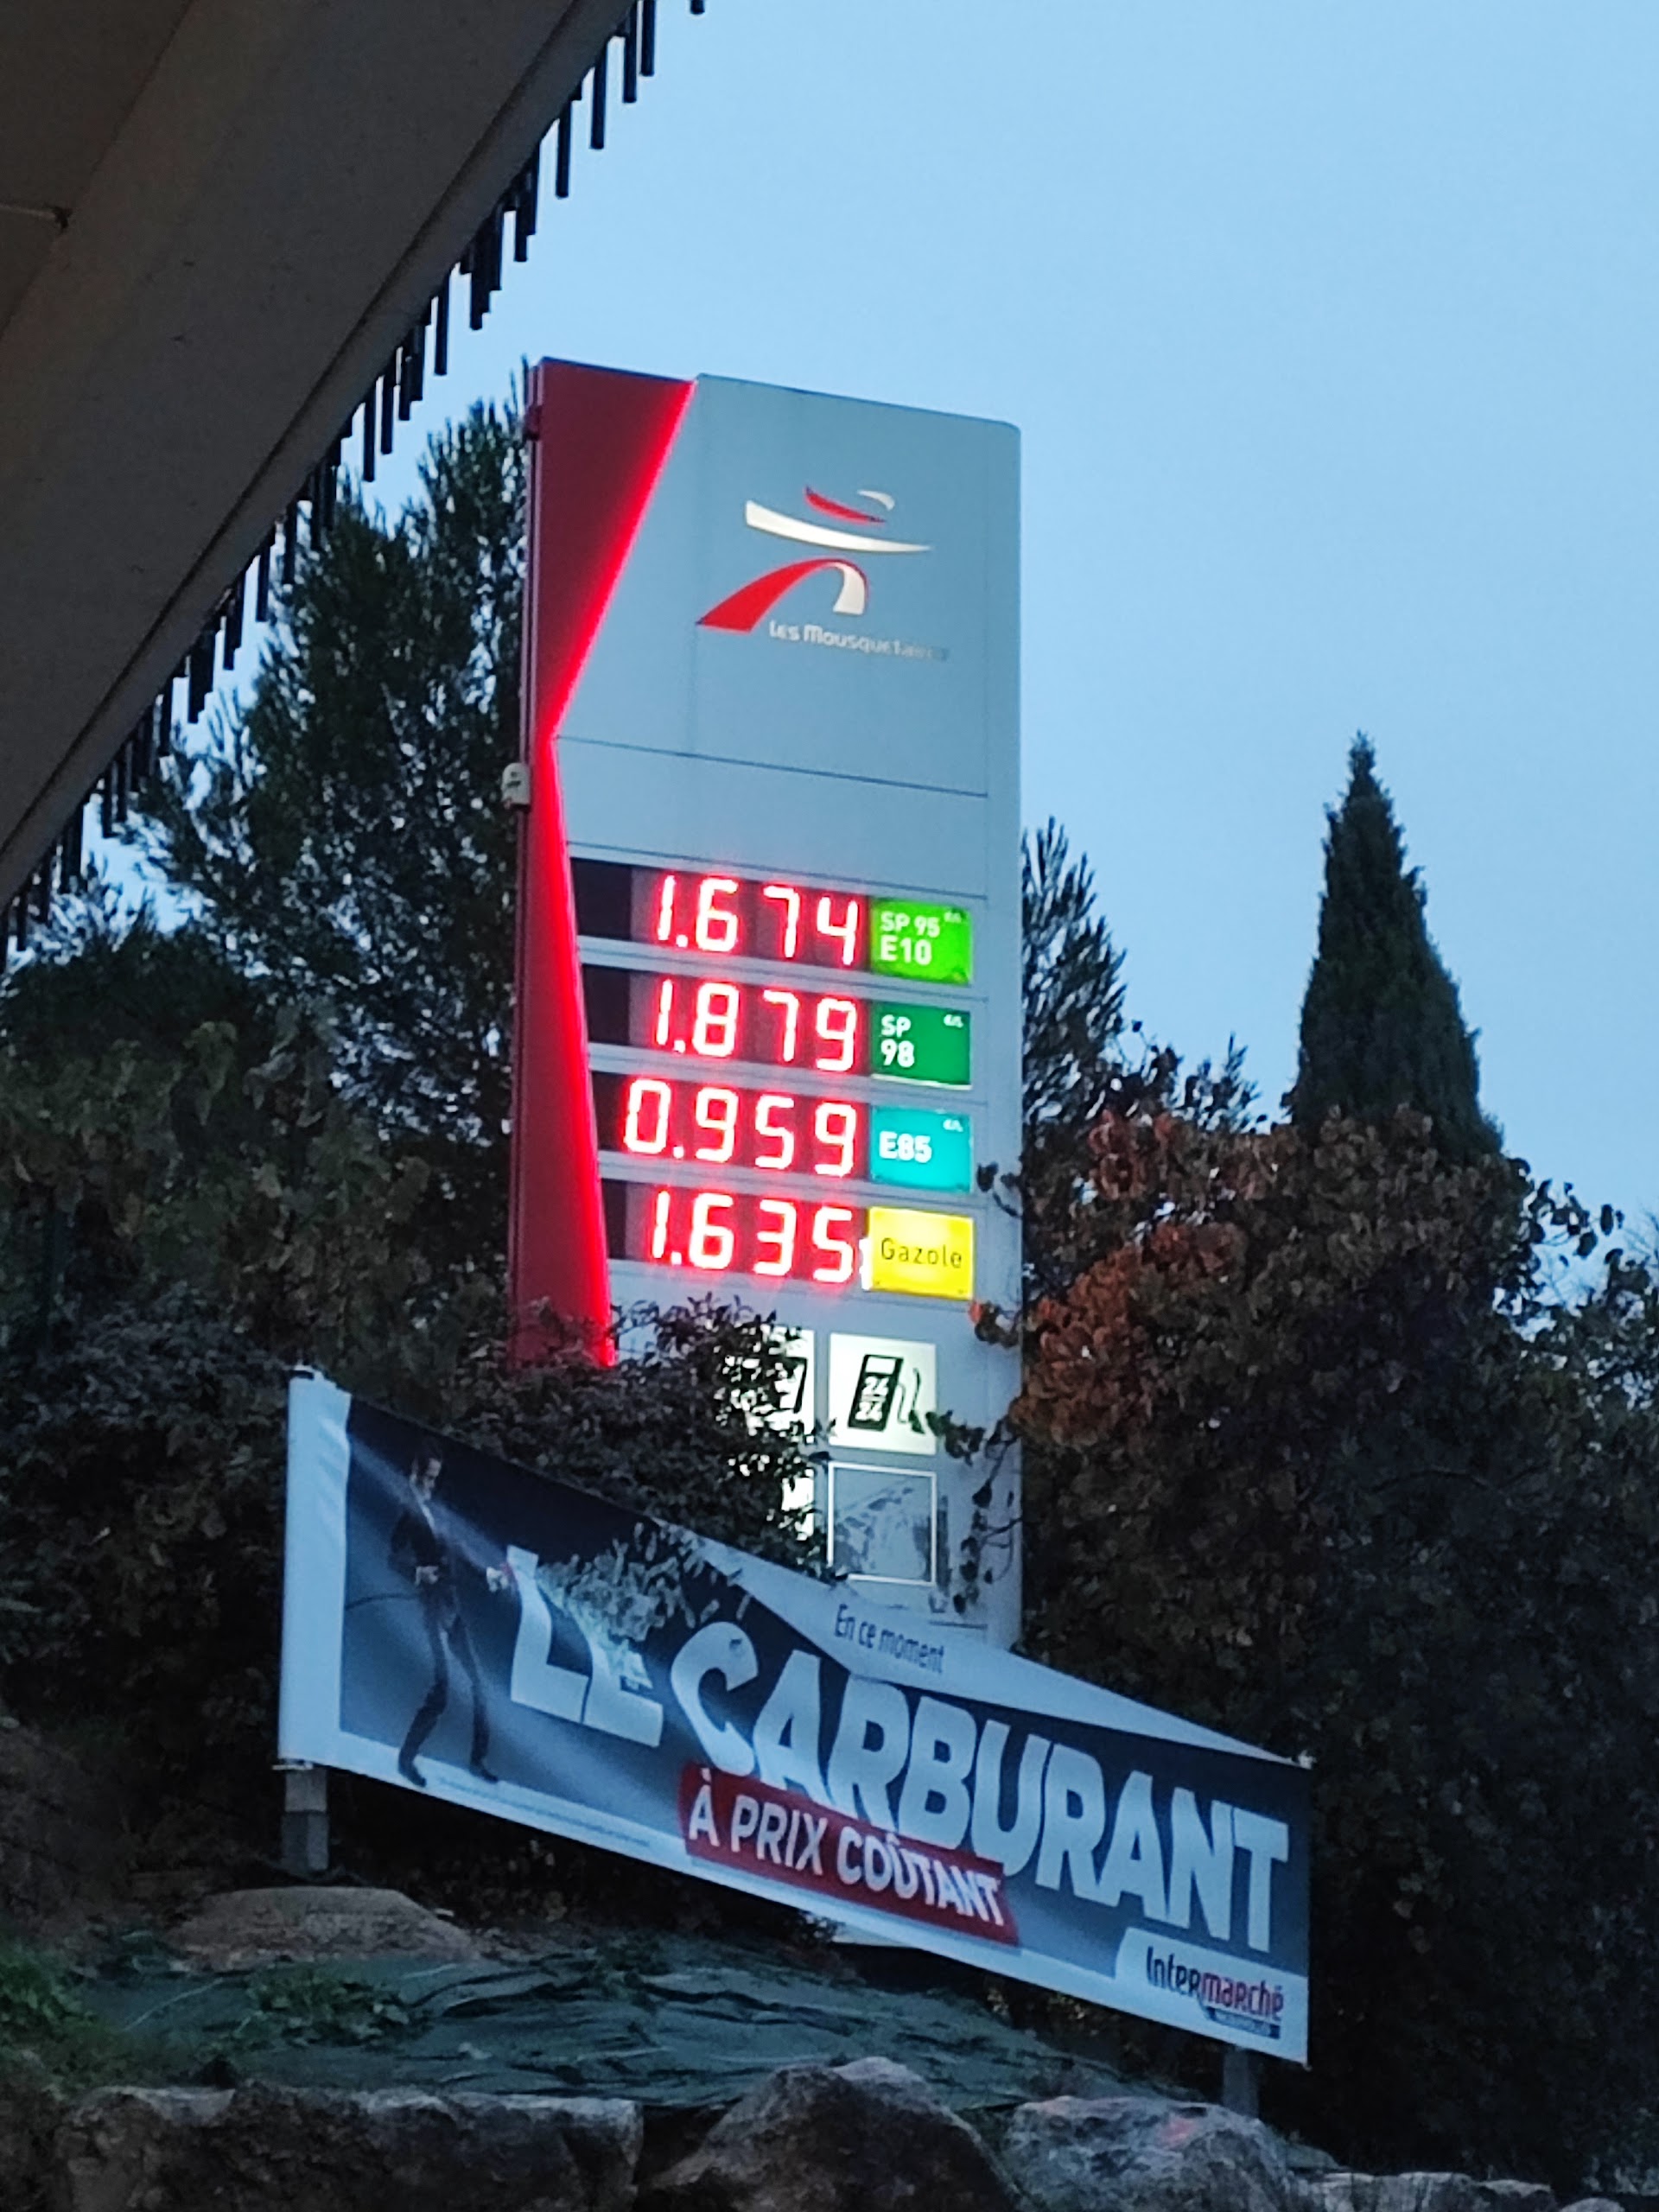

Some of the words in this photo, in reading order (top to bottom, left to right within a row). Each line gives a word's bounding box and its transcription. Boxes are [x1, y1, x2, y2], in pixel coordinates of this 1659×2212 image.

[769, 620, 800, 641] Les
[657, 874, 859, 965] 1.674
[880, 911, 911, 932] SP
[914, 915, 940, 938] 95
[880, 934, 932, 966] E10
[656, 979, 857, 1071] 1.879
[881, 1014, 912, 1038] SP
[881, 1039, 915, 1068] 98
[624, 1079, 857, 1177] 0.959
[880, 1130, 932, 1164] E85
[652, 1191, 855, 1283] 1.635
[880, 1236, 962, 1269] Gazole
[835, 1603, 855, 1641] En
[859, 1621, 876, 1649] ce
[878, 1629, 944, 1674] moment
[671, 1621, 1289, 1953] CARBURANT
[689, 1767, 720, 1847] À
[730, 1794, 827, 1875] PRIX
[836, 1825, 1005, 1926] COÛTANT
